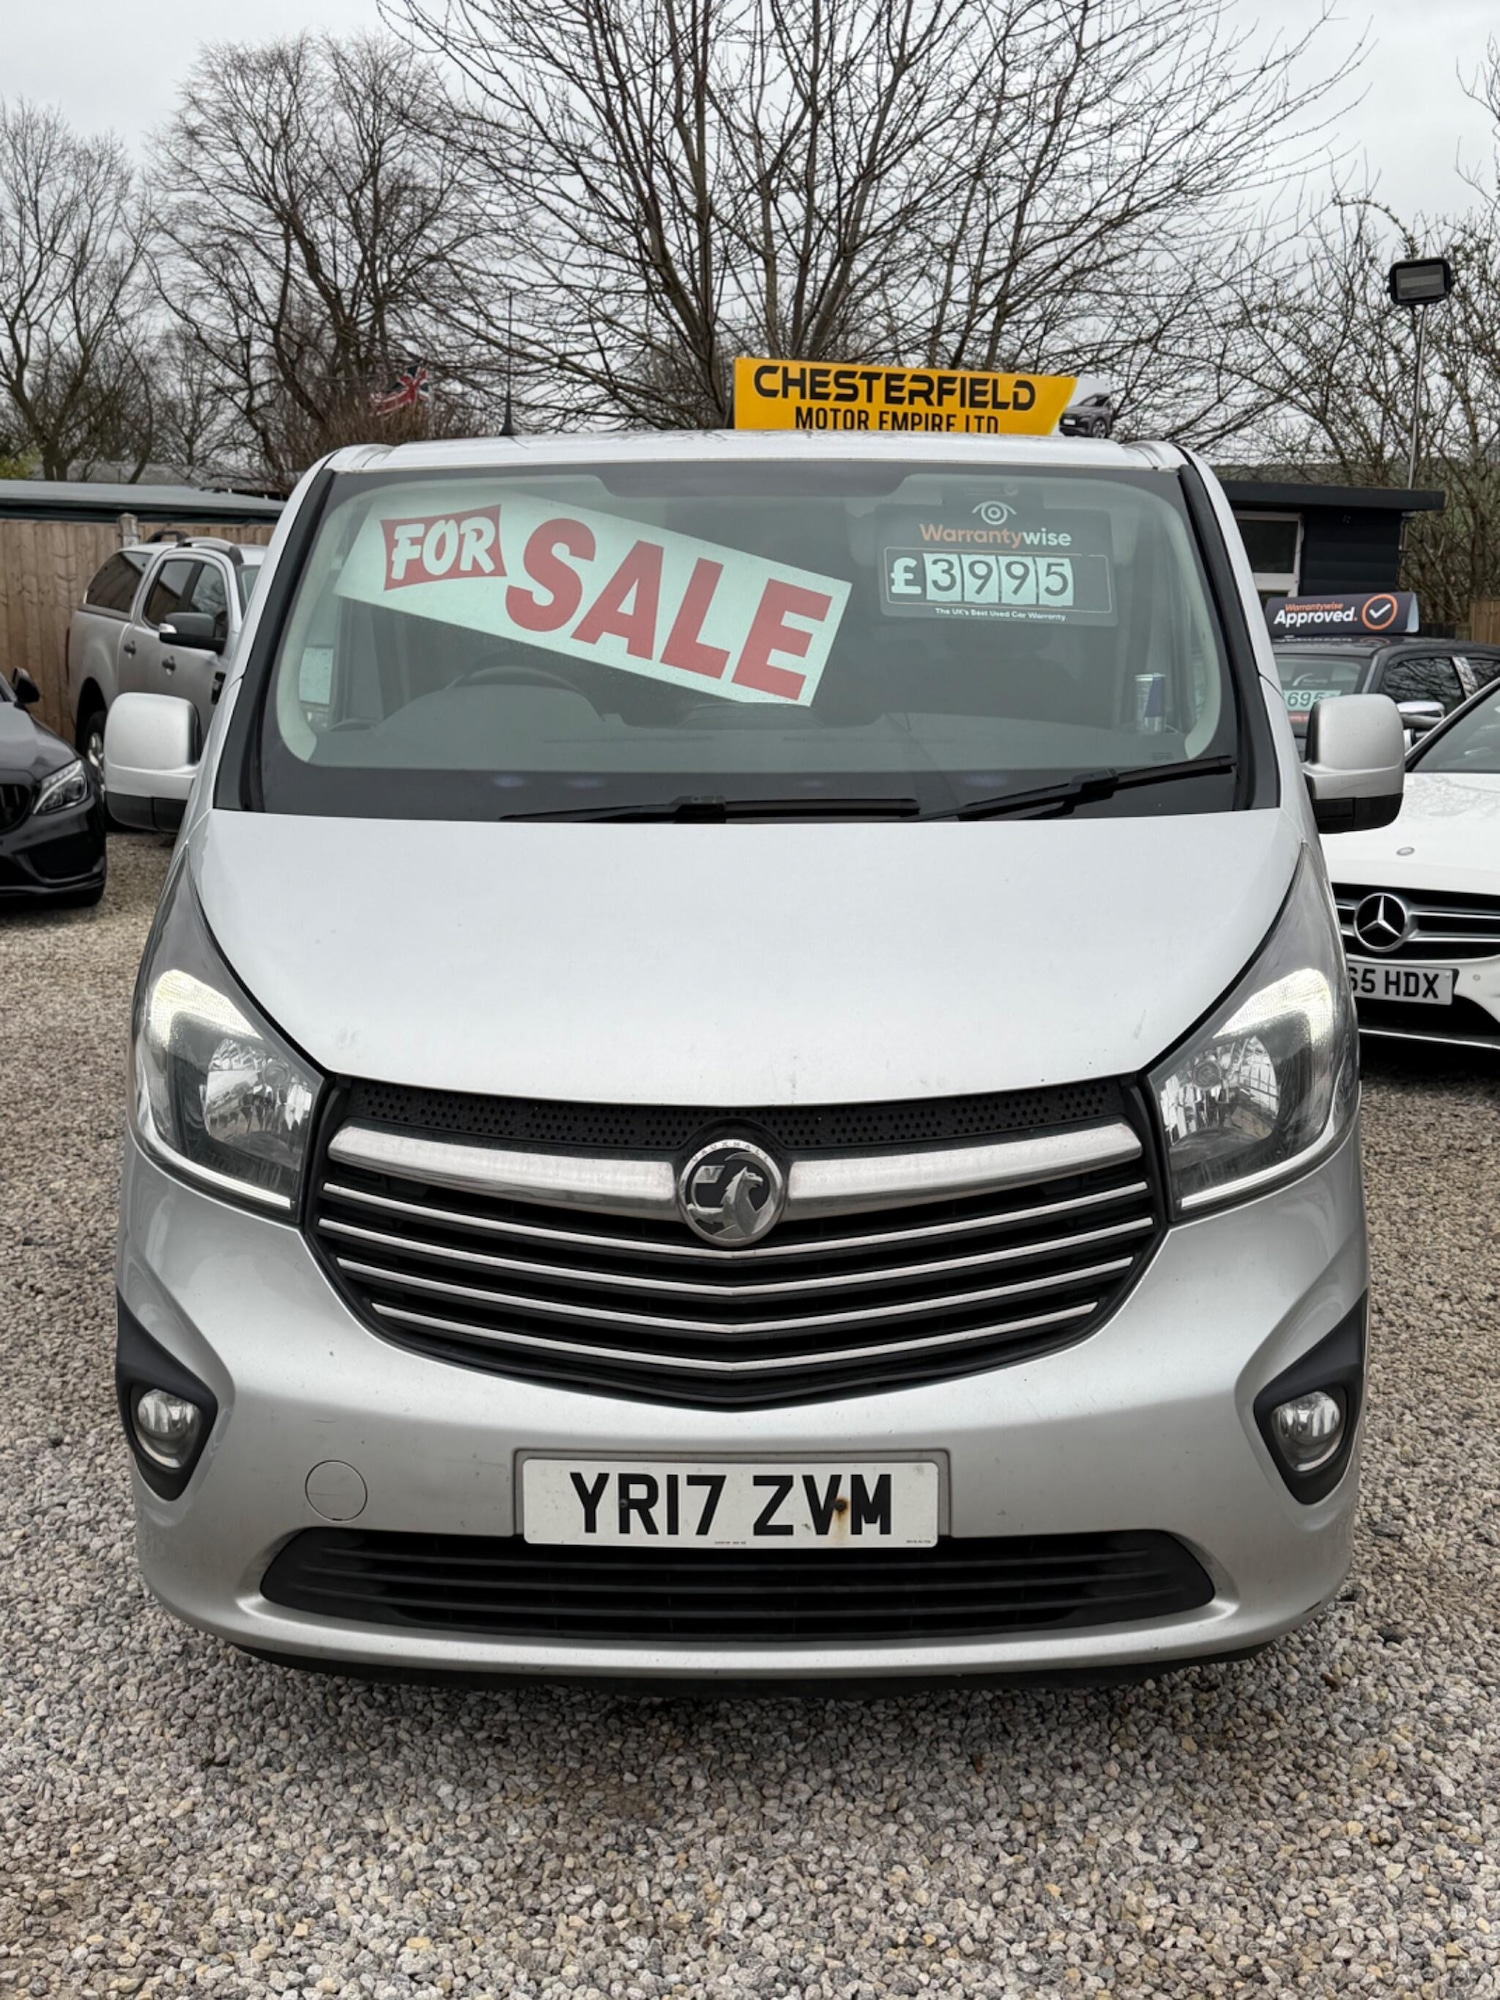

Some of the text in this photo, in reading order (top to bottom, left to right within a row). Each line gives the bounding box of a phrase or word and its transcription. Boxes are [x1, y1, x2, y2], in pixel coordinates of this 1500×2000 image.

[753, 365, 1036, 412] CHESTERFIELD
[795, 406, 999, 434] MOTOR EMPIRE LTD
[919, 523, 1072, 548] Warrantywise
[891, 556, 1069, 597] £3995
[390, 515, 833, 701] FOR SALE
[935, 607, 950, 615] The
[952, 608, 969, 616] UK's
[989, 610, 1010, 618] Used
[1028, 612, 1066, 621] Warranty
[1273, 606, 1358, 628] Approved.
[1285, 602, 1343, 611] Warrantywise
[1385, 970, 1439, 999] HDX
[570, 1471, 892, 1535] YR17 ZVM
